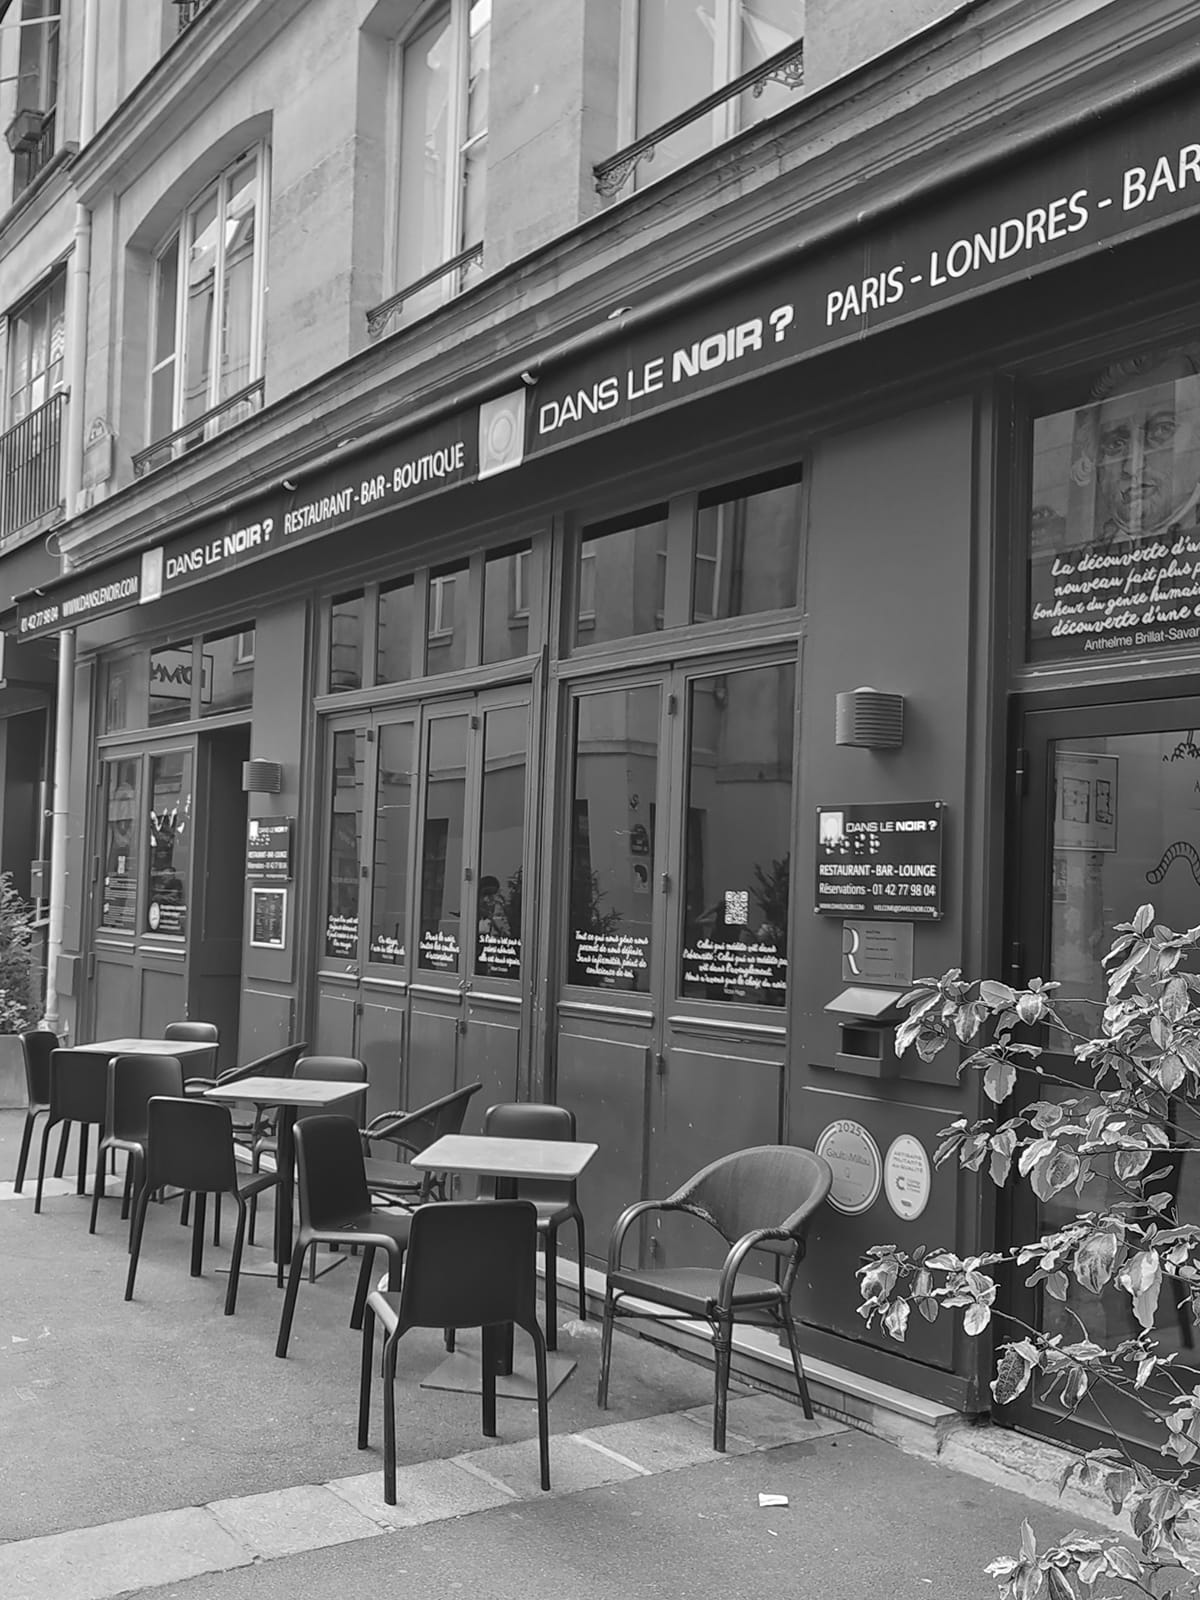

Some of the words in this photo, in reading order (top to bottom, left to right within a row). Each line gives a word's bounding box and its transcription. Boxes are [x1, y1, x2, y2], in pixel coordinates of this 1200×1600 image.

[826, 265, 904, 326] PARIS
[929, 189, 1089, 287] LONDRES
[1122, 143, 1200, 211] BAR
[538, 376, 619, 434] DANS
[627, 357, 664, 400] LE
[672, 317, 763, 383] NOIR
[284, 487, 354, 535] RESTAURANT
[360, 474, 385, 505] BAR
[393, 441, 465, 492] BOUTIQUE
[166, 548, 203, 579] DANS
[205, 540, 222, 565] LE
[223, 524, 262, 557] NOIR
[1051, 558, 1075, 576] La
[1077, 541, 1169, 572] découverte
[1054, 575, 1123, 596] nouveau
[1123, 566, 1157, 594] fait
[1155, 558, 1192, 586] plus
[1032, 601, 1085, 620] bonheur
[1086, 597, 1106, 612] du
[1105, 591, 1149, 615] genre
[1051, 609, 1140, 636] découverte
[1141, 604, 1191, 624] d'une
[1084, 635, 1133, 651] Anthelme
[846, 821, 878, 833] DANS
[880, 821, 894, 832] LE
[895, 820, 926, 831] NOIR
[819, 864, 871, 876] RESTAURANT
[875, 864, 894, 876] BAR
[899, 864, 937, 877] LOUNGE
[819, 882, 866, 895] Réservations
[872, 883, 883, 895] 01
[884, 884, 896, 895] 42
[897, 884, 908, 896] 77
[910, 884, 922, 896] 98
[923, 884, 936, 896] 04
[836, 1122, 862, 1137] 2025
